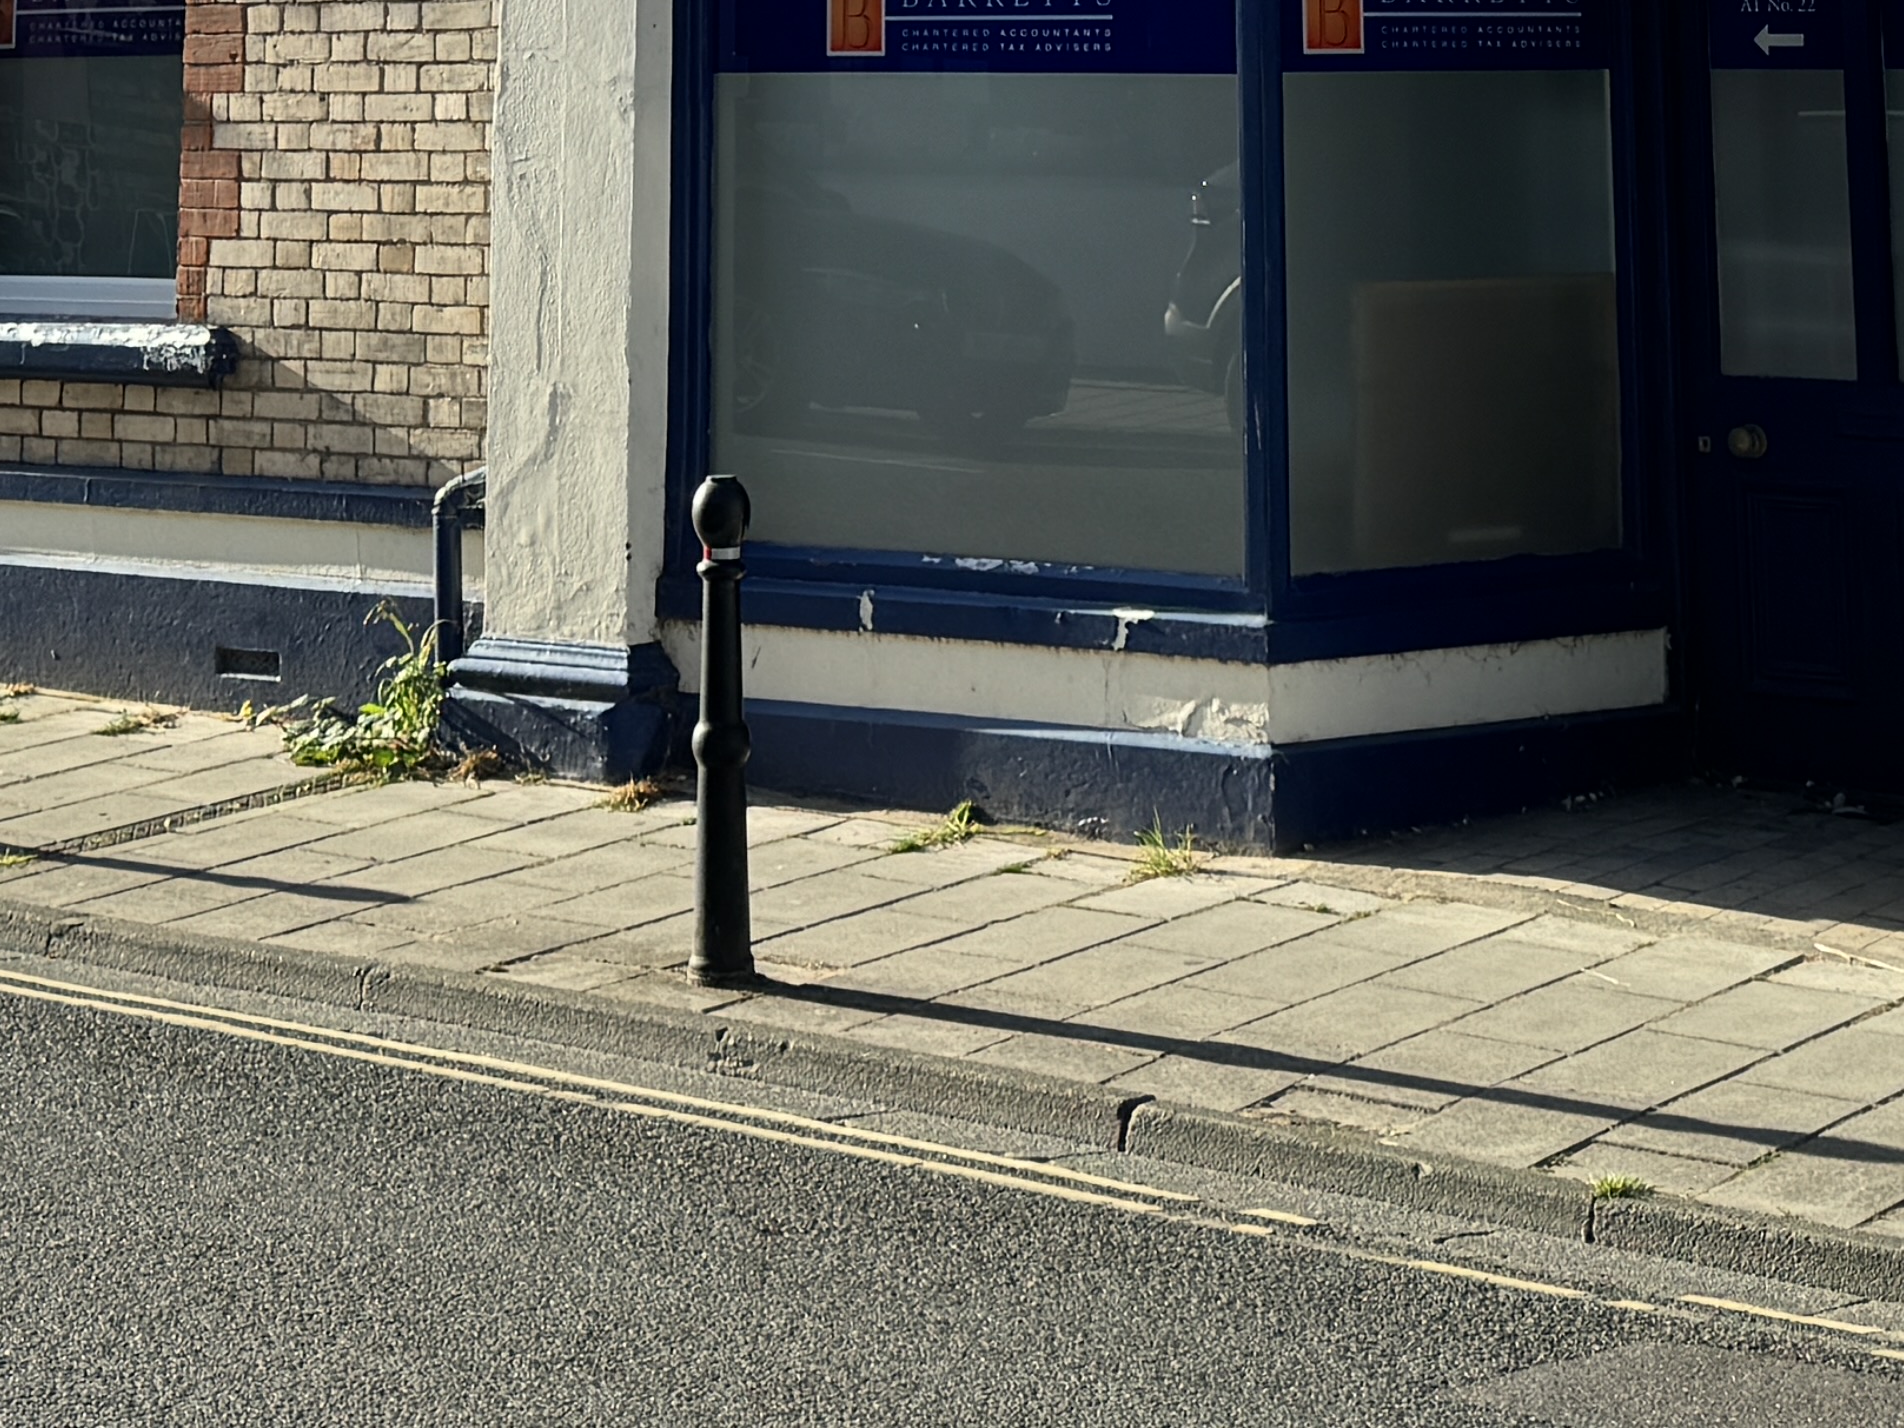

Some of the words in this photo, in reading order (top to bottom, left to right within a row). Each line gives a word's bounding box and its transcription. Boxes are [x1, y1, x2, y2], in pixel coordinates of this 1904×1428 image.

[112, 18, 183, 29] ACCOUNTA
[902, 28, 990, 38] CHARTERED
[1000, 28, 1112, 38] ACCOUNTANTS
[1381, 26, 1468, 35] CHARTERED
[1477, 25, 1581, 35] ACCOUNTANTS
[142, 31, 182, 41] ADVIS
[902, 43, 990, 52] CHARTERED
[1000, 43, 1025, 52] TAX
[1035, 42, 1112, 52] ADVISERS
[1381, 40, 1468, 49] CHARTERED
[1478, 40, 1501, 49] TAX
[1512, 40, 1581, 49] ADVISERS
